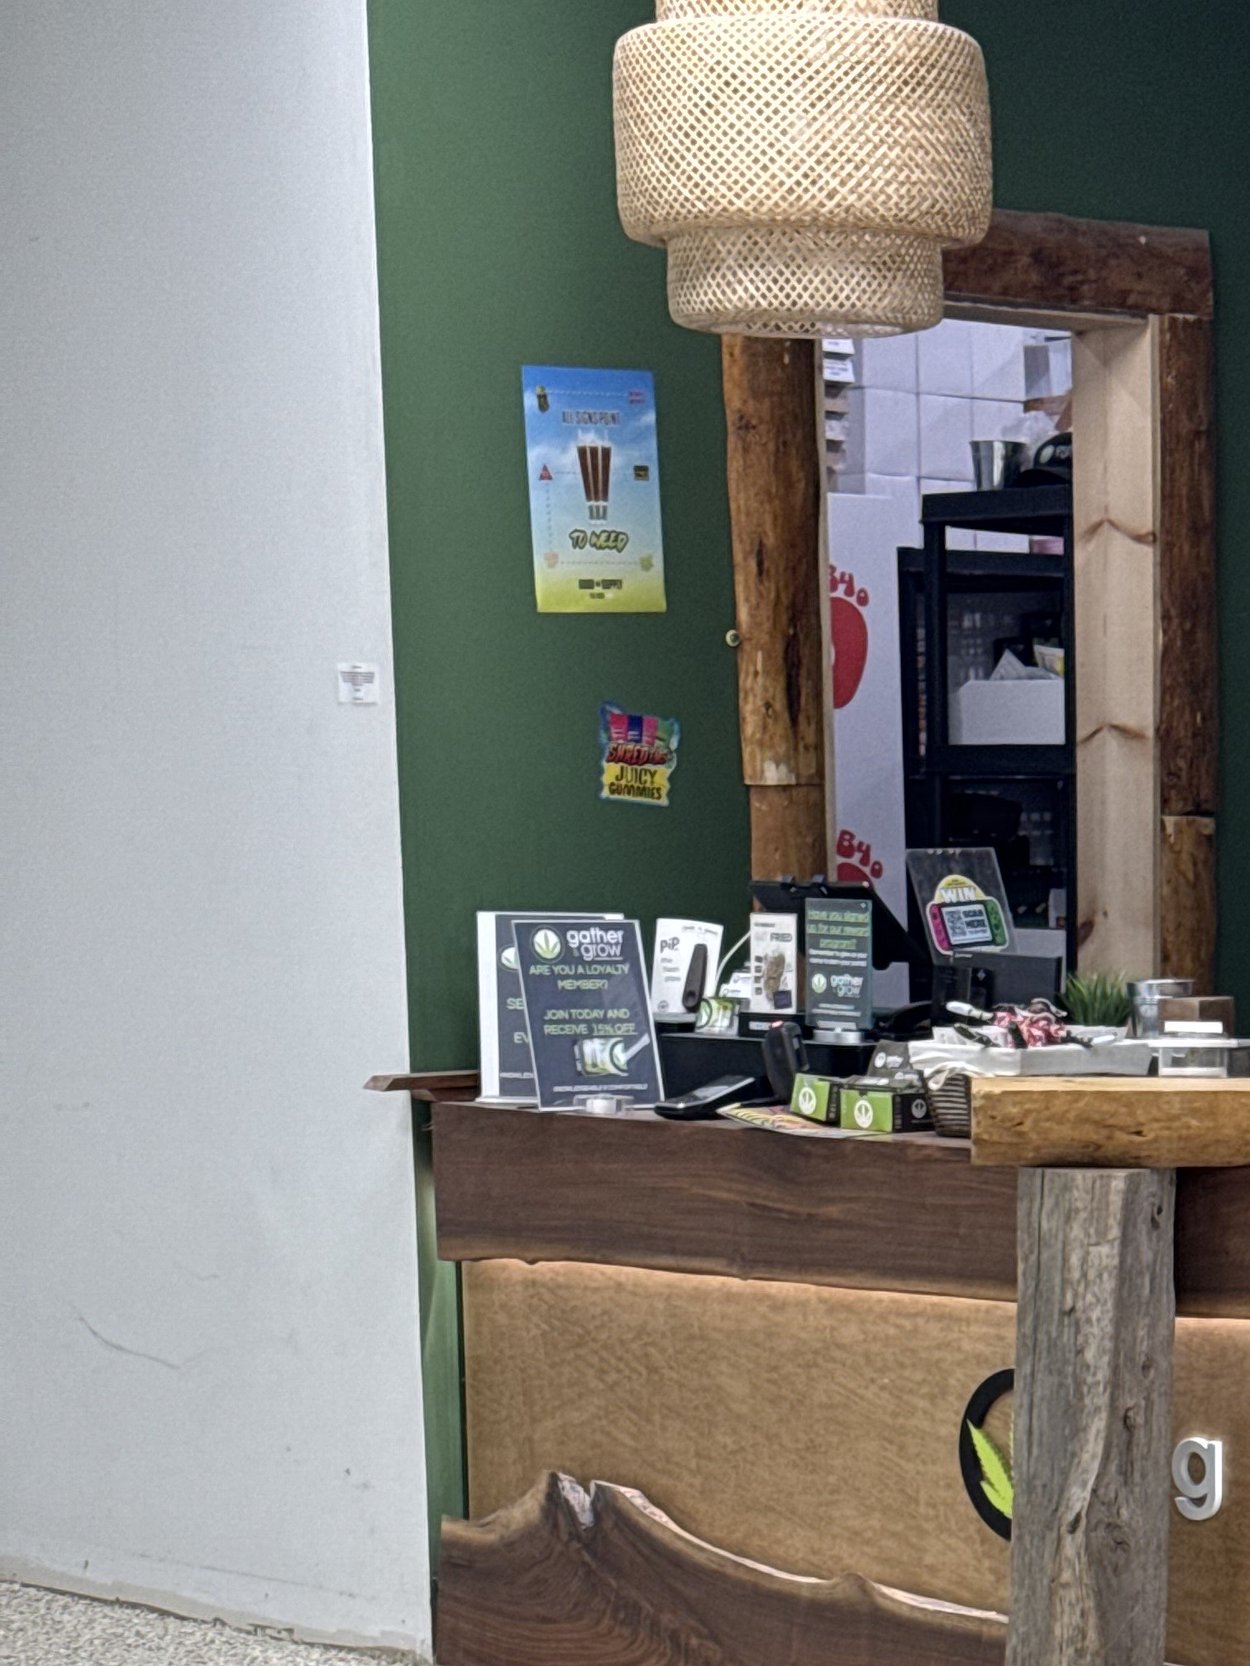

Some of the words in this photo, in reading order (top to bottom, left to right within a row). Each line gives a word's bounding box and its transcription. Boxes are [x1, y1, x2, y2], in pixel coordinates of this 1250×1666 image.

[615, 765, 657, 785] JUICY
[608, 782, 662, 800] GUMMIES
[940, 886, 978, 903] WIN
[567, 927, 624, 947] gather
[581, 943, 622, 961] grow
[529, 964, 551, 975] ARE
[552, 964, 575, 975] YOU
[586, 963, 630, 975] LOYALTY
[543, 1009, 570, 1020] JOIN
[571, 1008, 605, 1020] TODAY
[607, 1008, 630, 1019] AND
